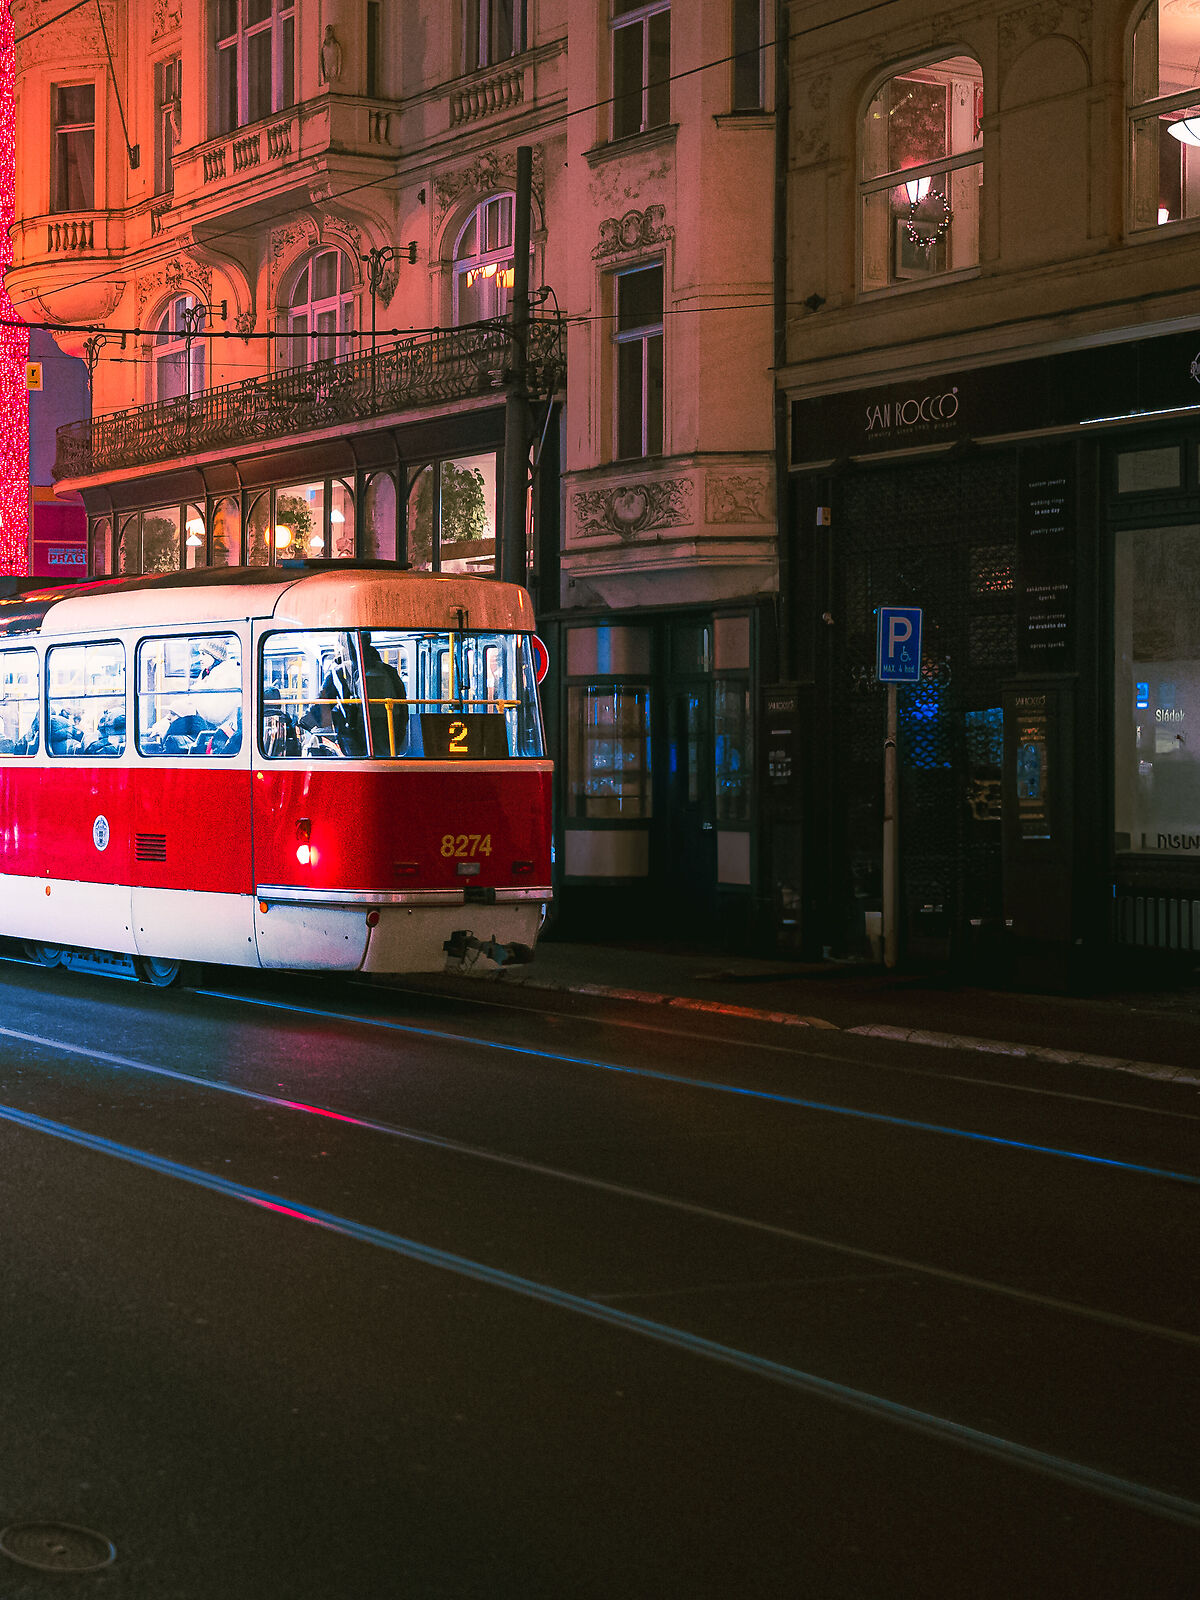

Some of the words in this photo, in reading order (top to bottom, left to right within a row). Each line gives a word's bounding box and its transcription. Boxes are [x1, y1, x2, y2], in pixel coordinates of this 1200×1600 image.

[864, 404, 890, 431] SAN
[895, 393, 959, 425] ROCCO
[888, 616, 913, 658] P
[449, 721, 468, 752] 2
[440, 834, 492, 857] 8274
